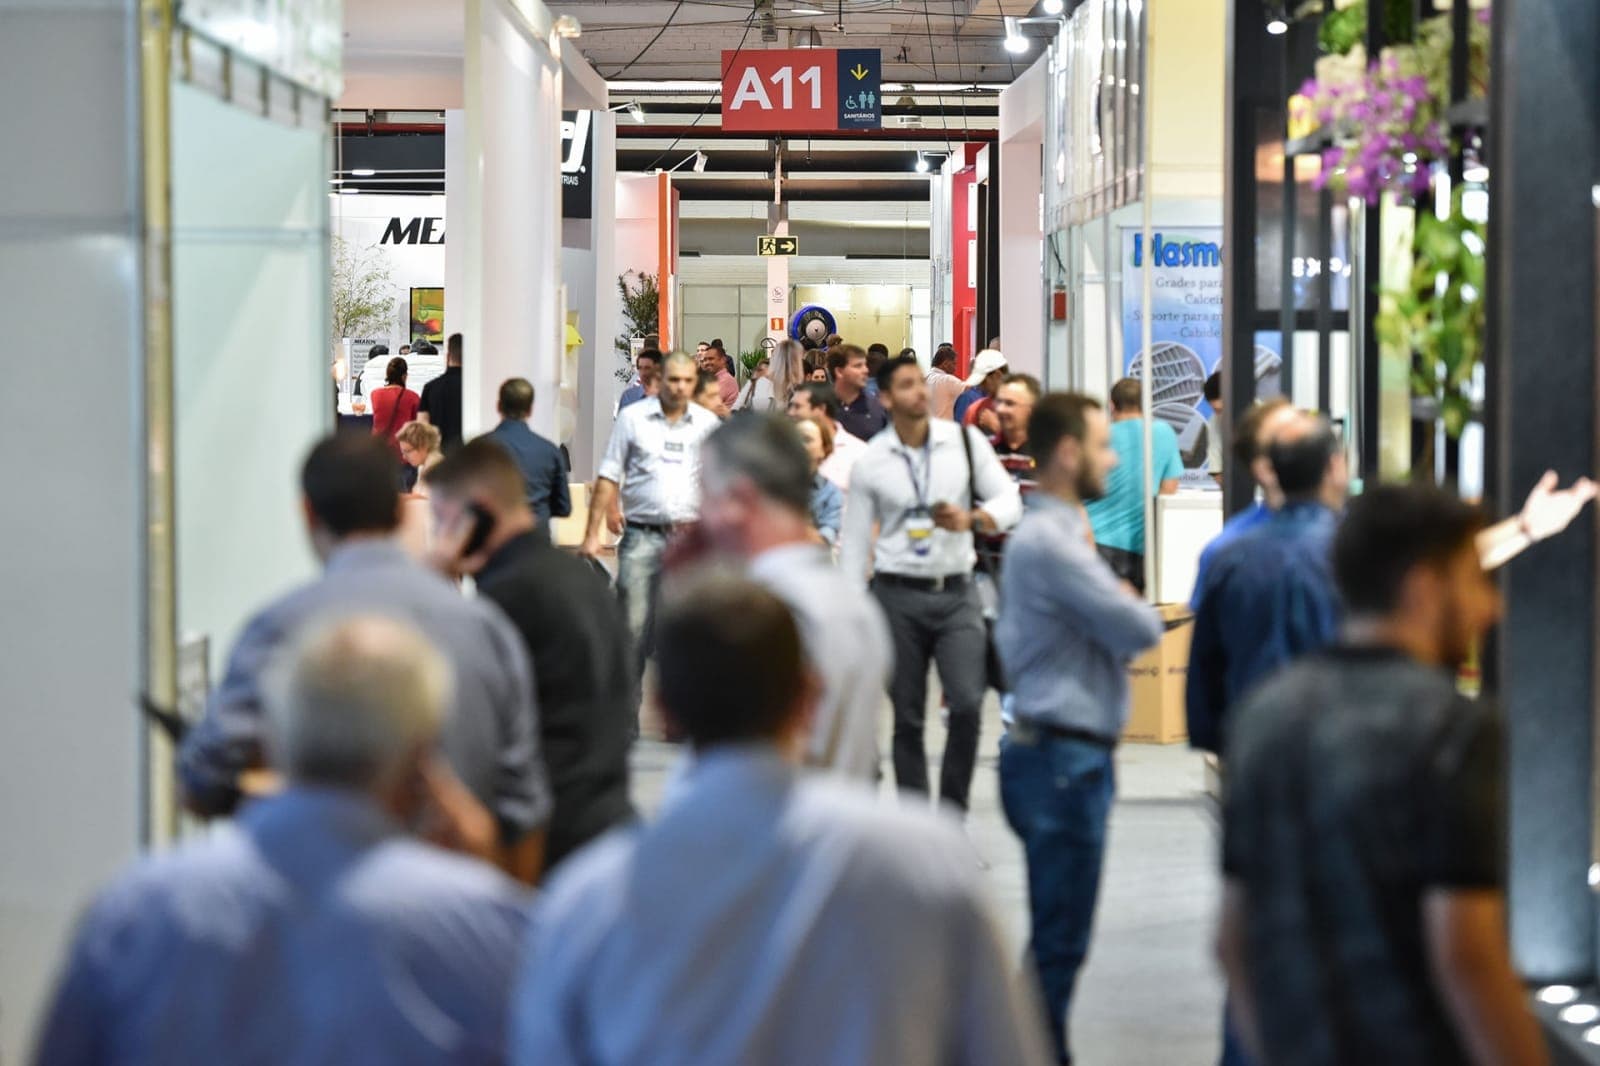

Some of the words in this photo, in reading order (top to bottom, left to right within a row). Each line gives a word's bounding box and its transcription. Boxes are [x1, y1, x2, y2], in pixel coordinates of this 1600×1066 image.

[729, 65, 822, 110] A11
[380, 217, 445, 245] ME
[1133, 232, 1223, 268] Plasm
[1155, 276, 1197, 288] Grades
[1180, 326, 1223, 338] Cabide
